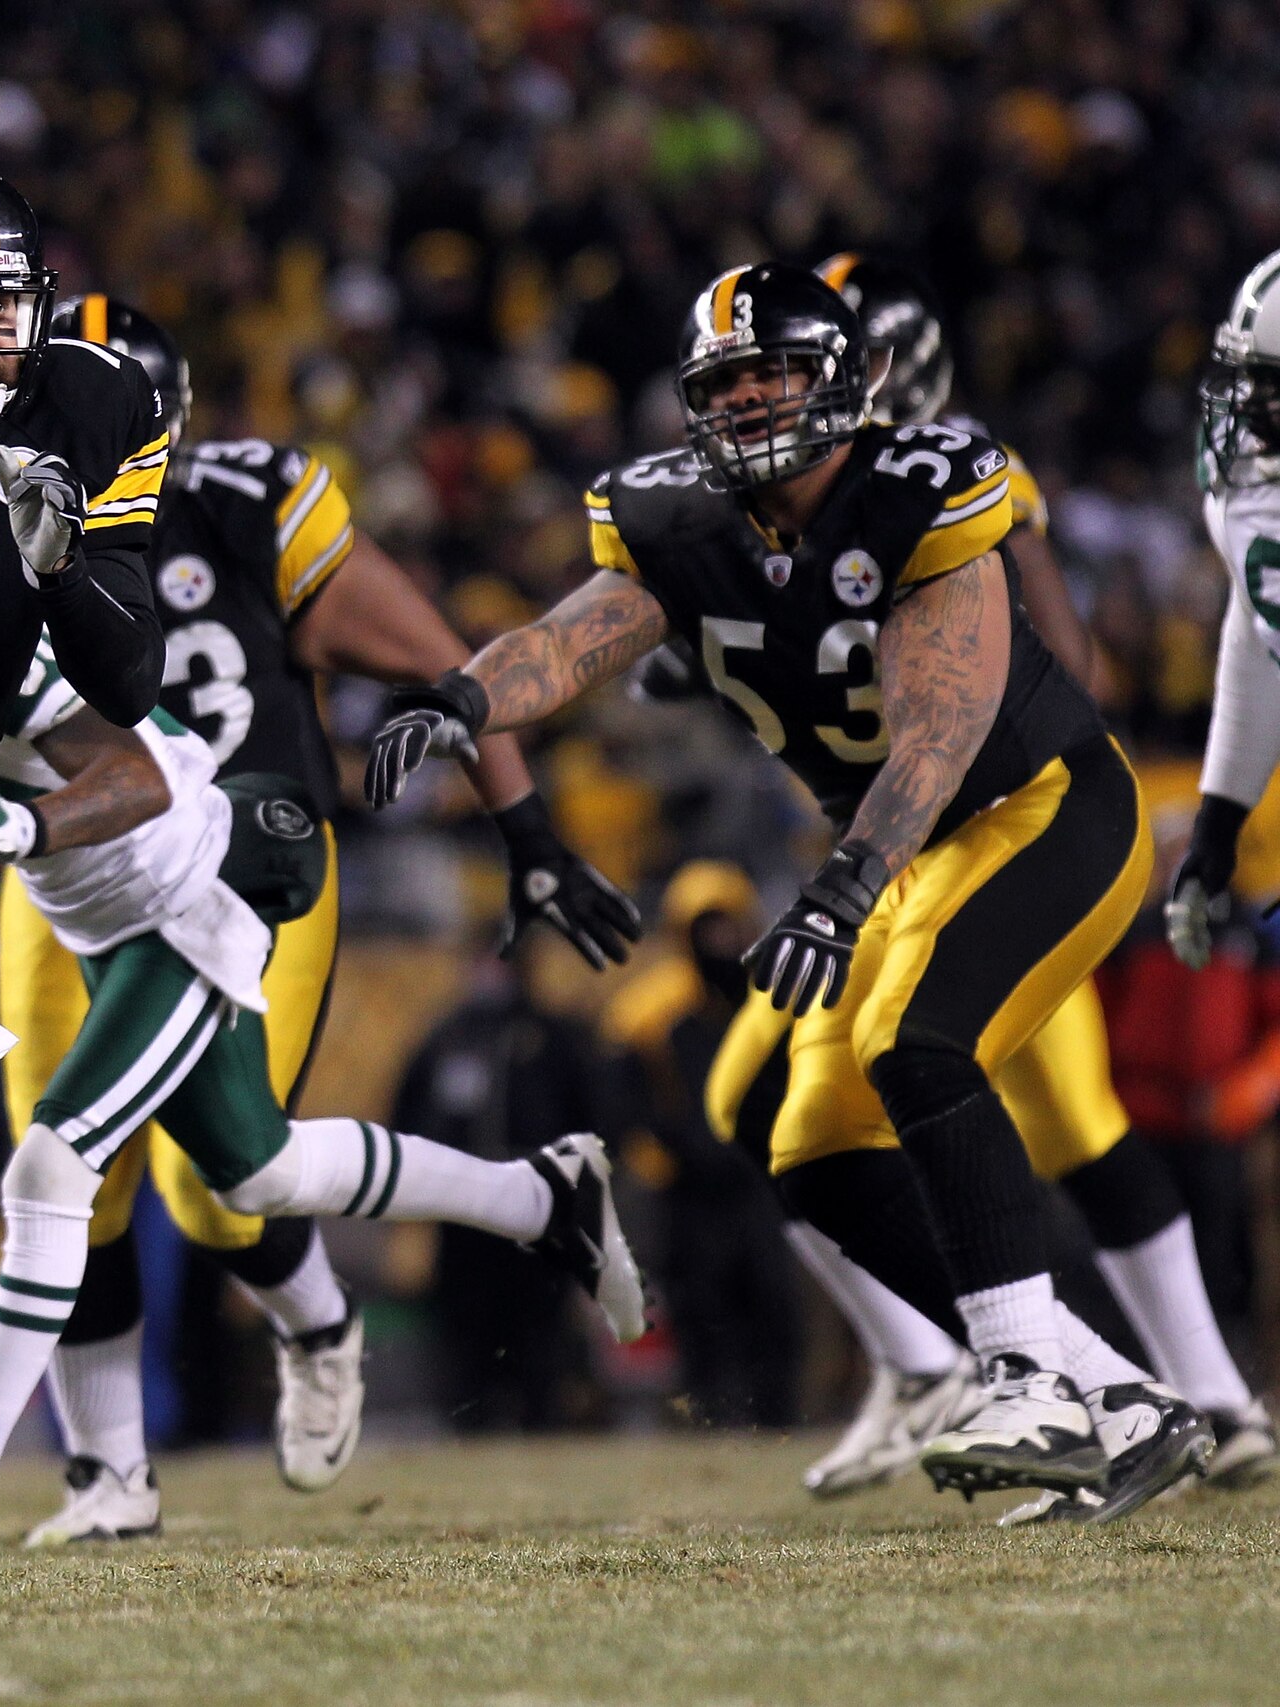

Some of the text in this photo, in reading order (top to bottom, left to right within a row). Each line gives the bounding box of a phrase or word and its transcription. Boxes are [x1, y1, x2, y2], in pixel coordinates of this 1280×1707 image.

[187, 437, 275, 500] 73
[874, 423, 972, 489] 53
[701, 615, 891, 764] 53
